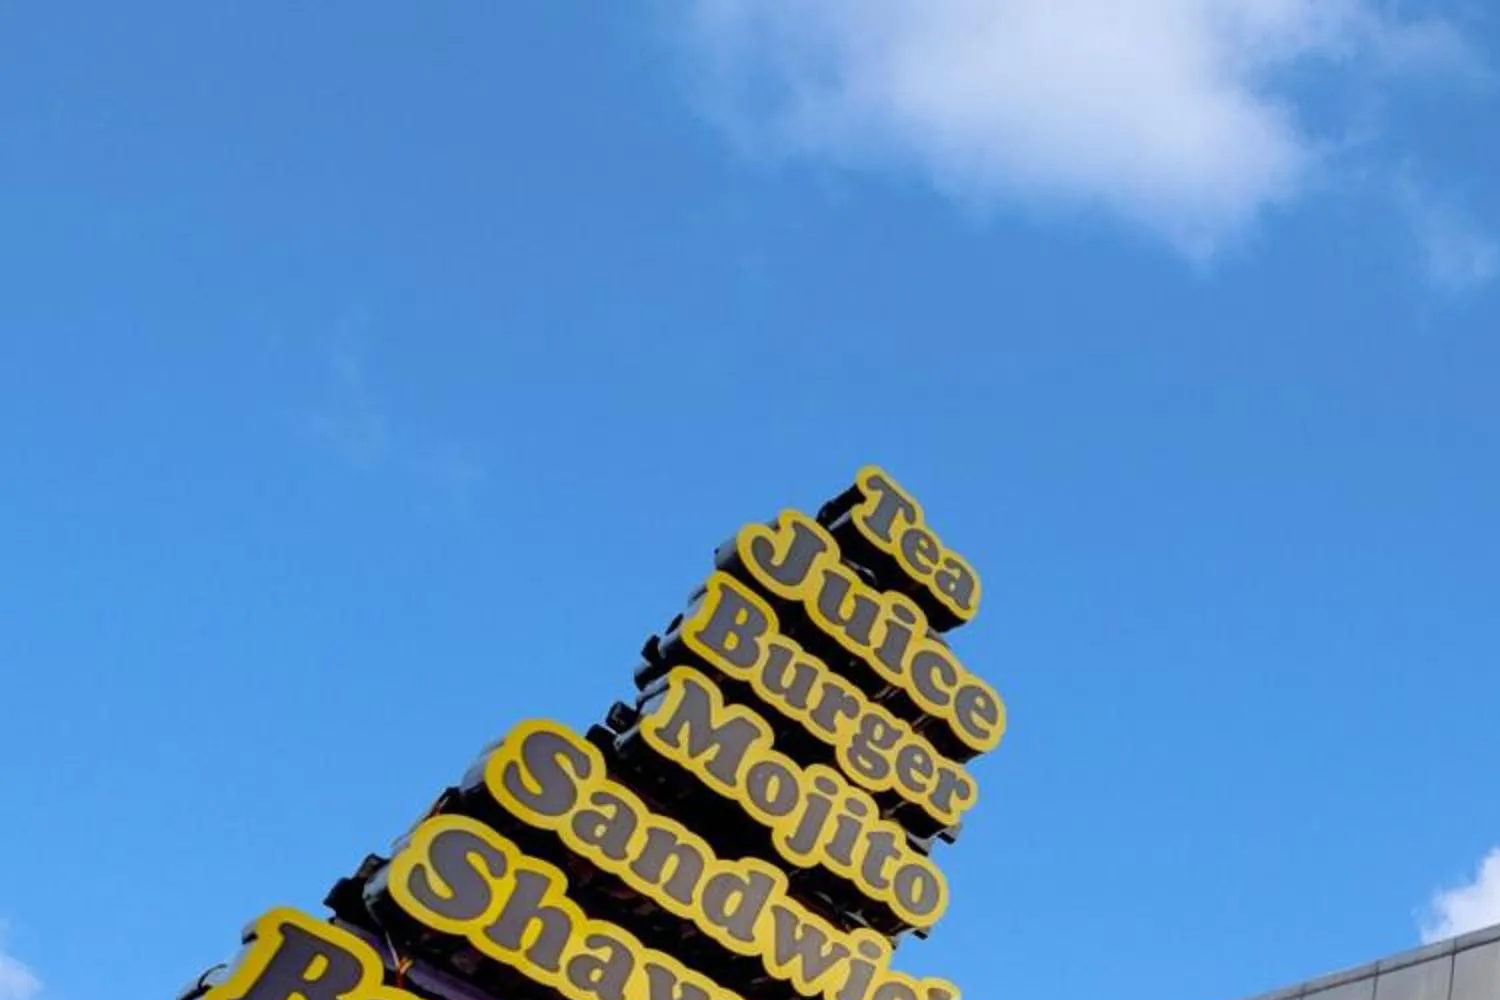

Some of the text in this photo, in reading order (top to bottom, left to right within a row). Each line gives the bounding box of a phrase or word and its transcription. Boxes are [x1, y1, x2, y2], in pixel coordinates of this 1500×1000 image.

[747, 519, 999, 742] Juice
[858, 475, 978, 611] Tea
[653, 685, 943, 920] Mojito
[694, 581, 973, 815] Burger
